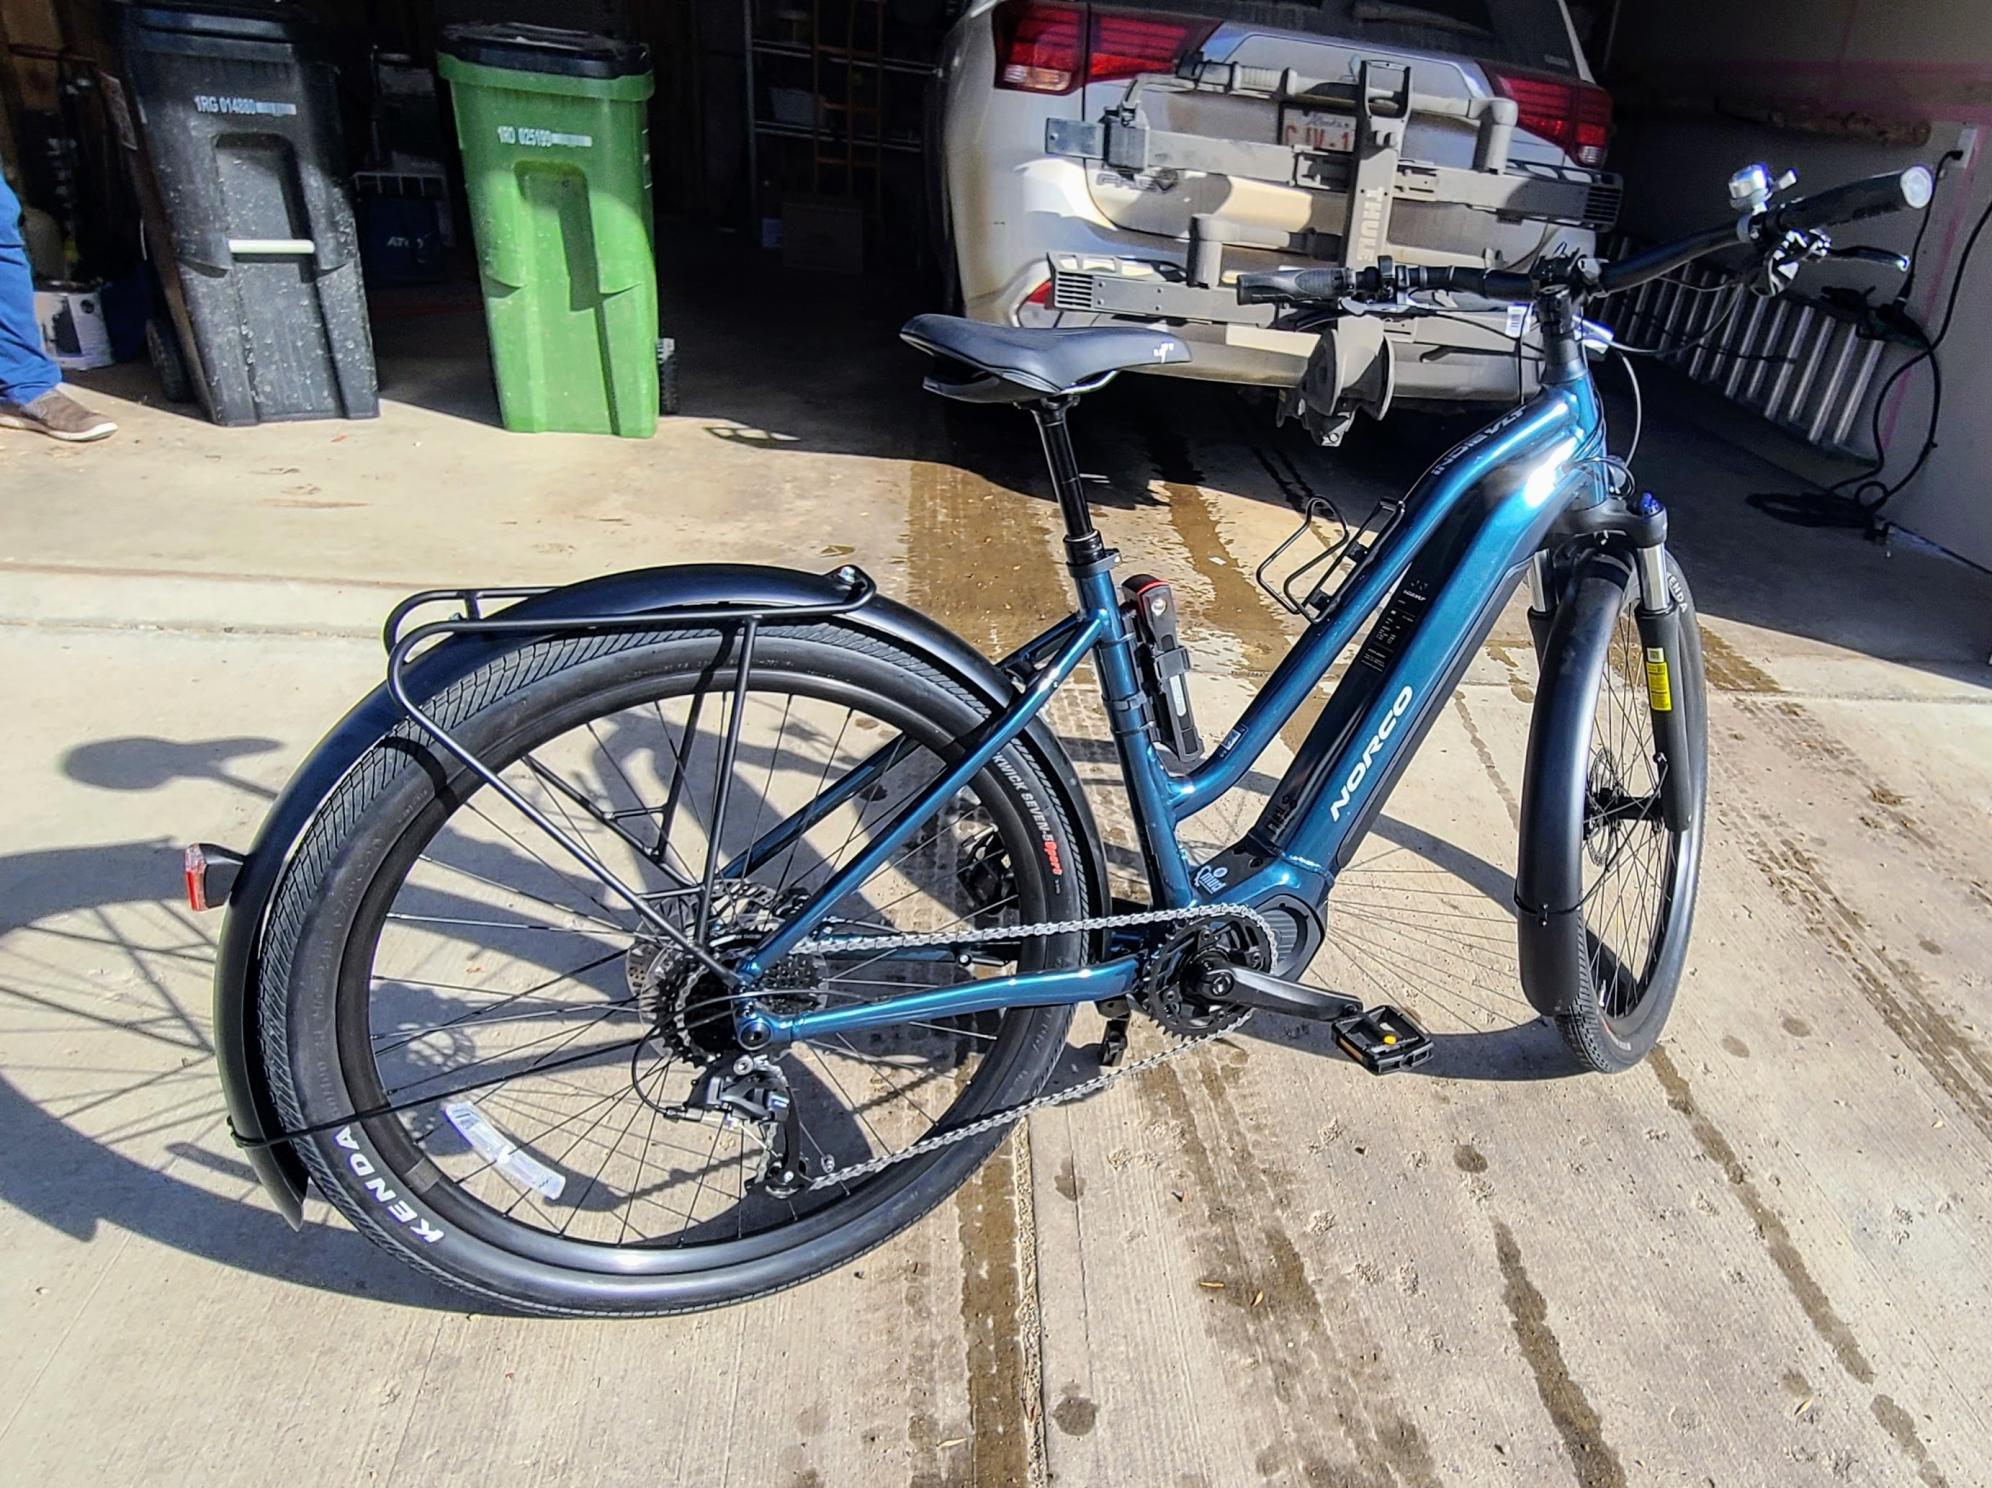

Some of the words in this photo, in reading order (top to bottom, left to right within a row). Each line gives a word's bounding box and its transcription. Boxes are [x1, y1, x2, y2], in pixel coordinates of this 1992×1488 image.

[1356, 186, 1385, 262] THULE
[1329, 685, 1413, 822] NORCO
[334, 1126, 445, 1243] KENDA
